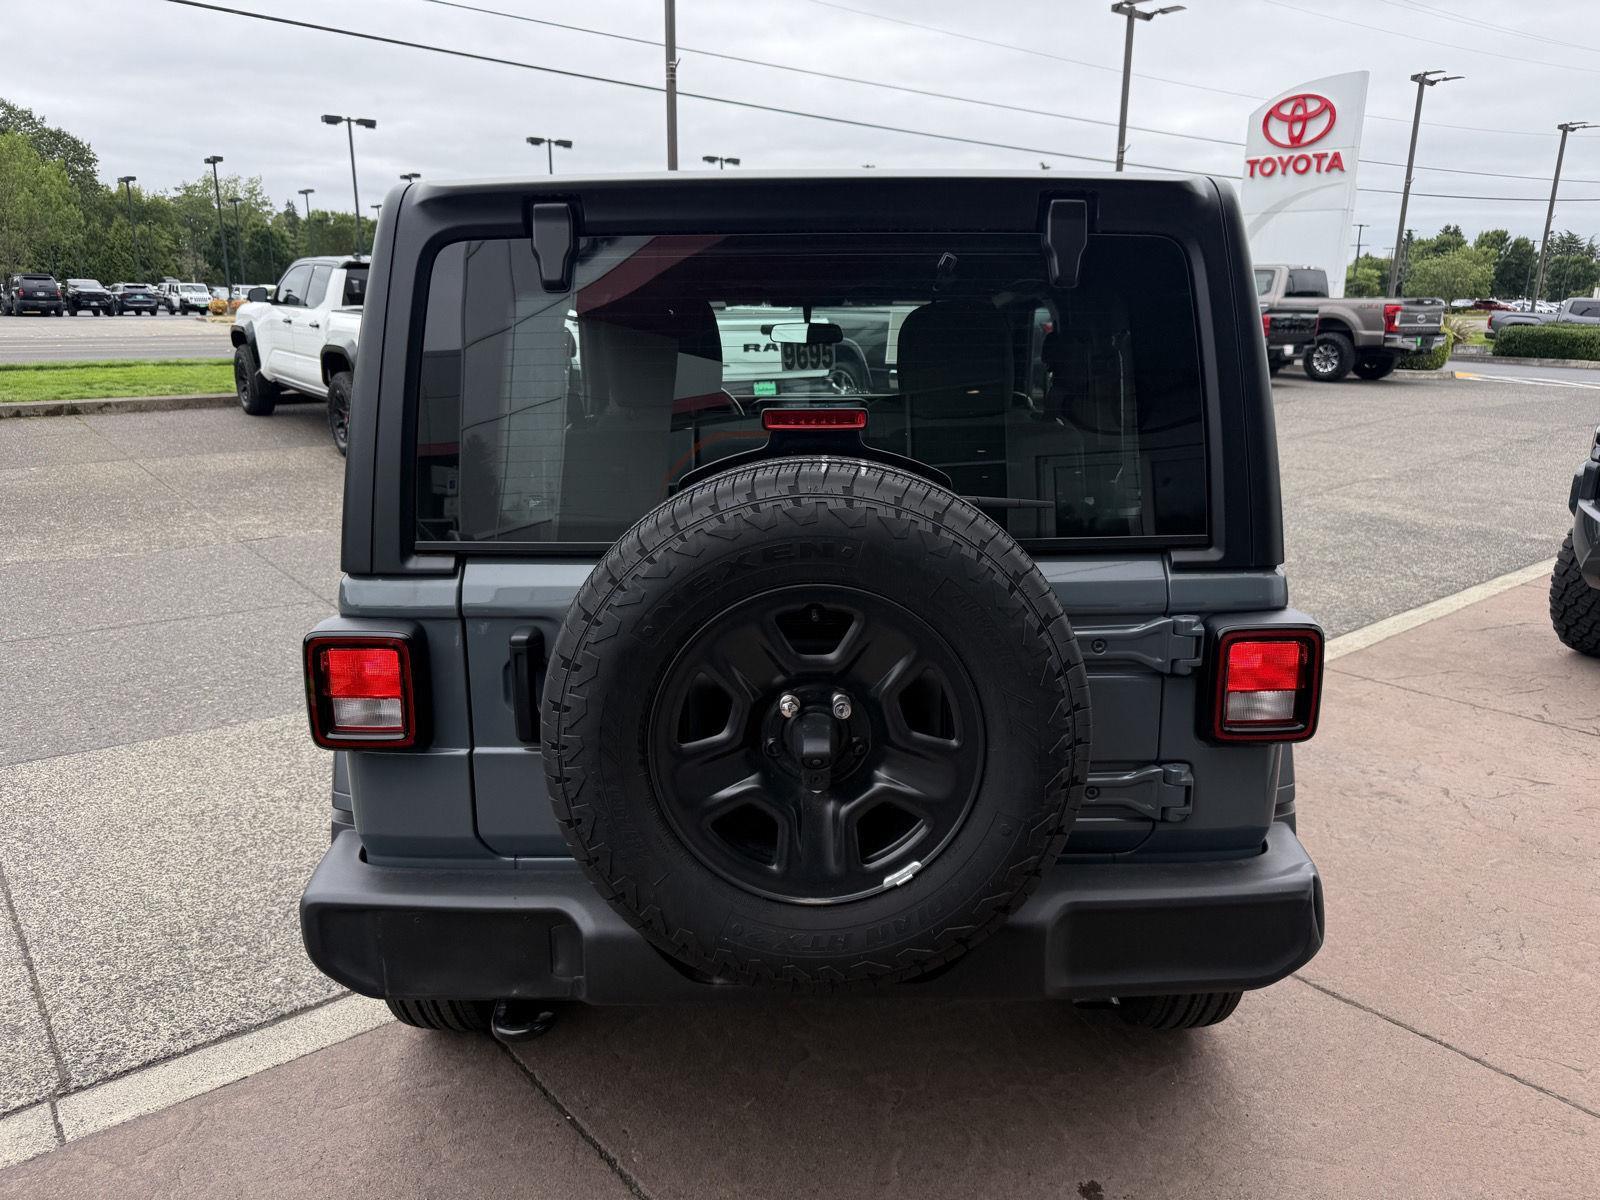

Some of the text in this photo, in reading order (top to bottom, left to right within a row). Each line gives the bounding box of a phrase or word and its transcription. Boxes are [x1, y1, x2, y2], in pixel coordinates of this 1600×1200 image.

[1247, 152, 1345, 178] TOYOTA
[743, 343, 779, 352] RA
[783, 342, 833, 370] 9695
[651, 541, 835, 624] NEXEN
